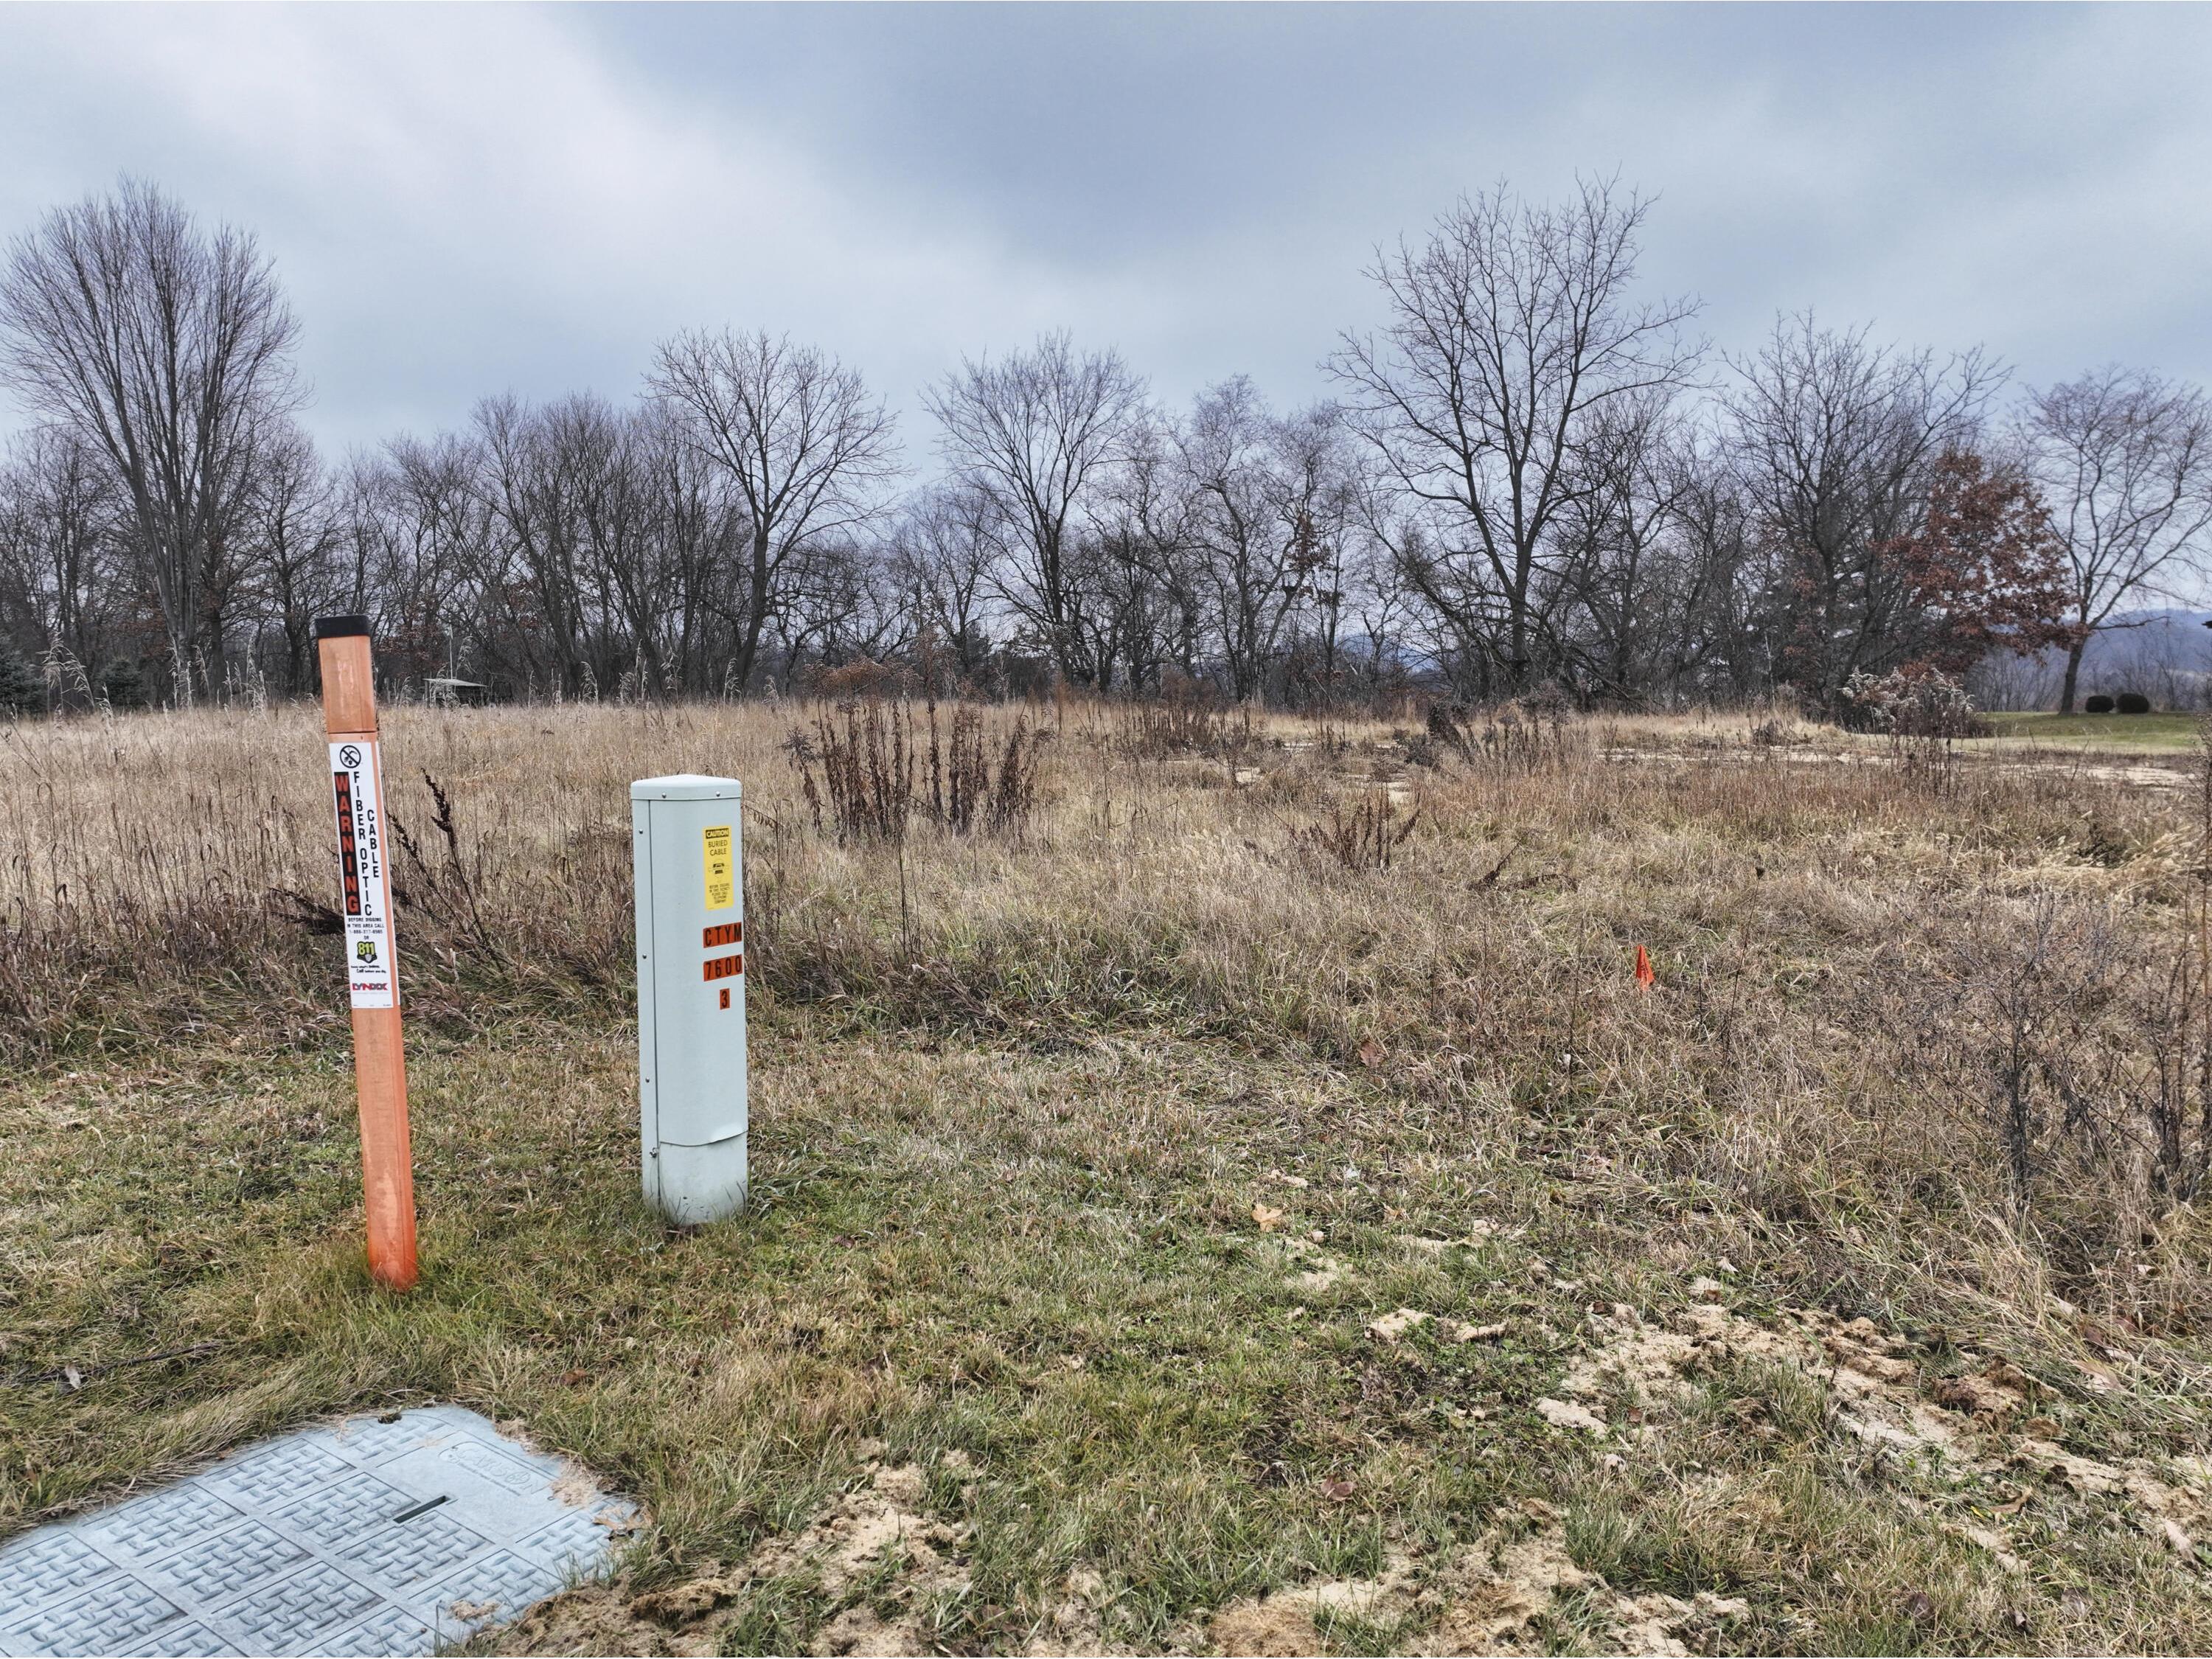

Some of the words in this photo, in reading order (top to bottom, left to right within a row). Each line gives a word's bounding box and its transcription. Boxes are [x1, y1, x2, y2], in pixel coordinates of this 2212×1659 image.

[335, 775, 360, 913] WARNING
[354, 771, 366, 840] FIBER
[360, 848, 372, 916] OPTIC
[366, 810, 379, 878] CABLE
[706, 830, 728, 838] CAUTION
[709, 848, 726, 856] CABLE
[705, 924, 742, 946] CTYM
[358, 942, 375, 956] 811
[706, 956, 741, 979] 7600
[721, 990, 728, 1008] 3
